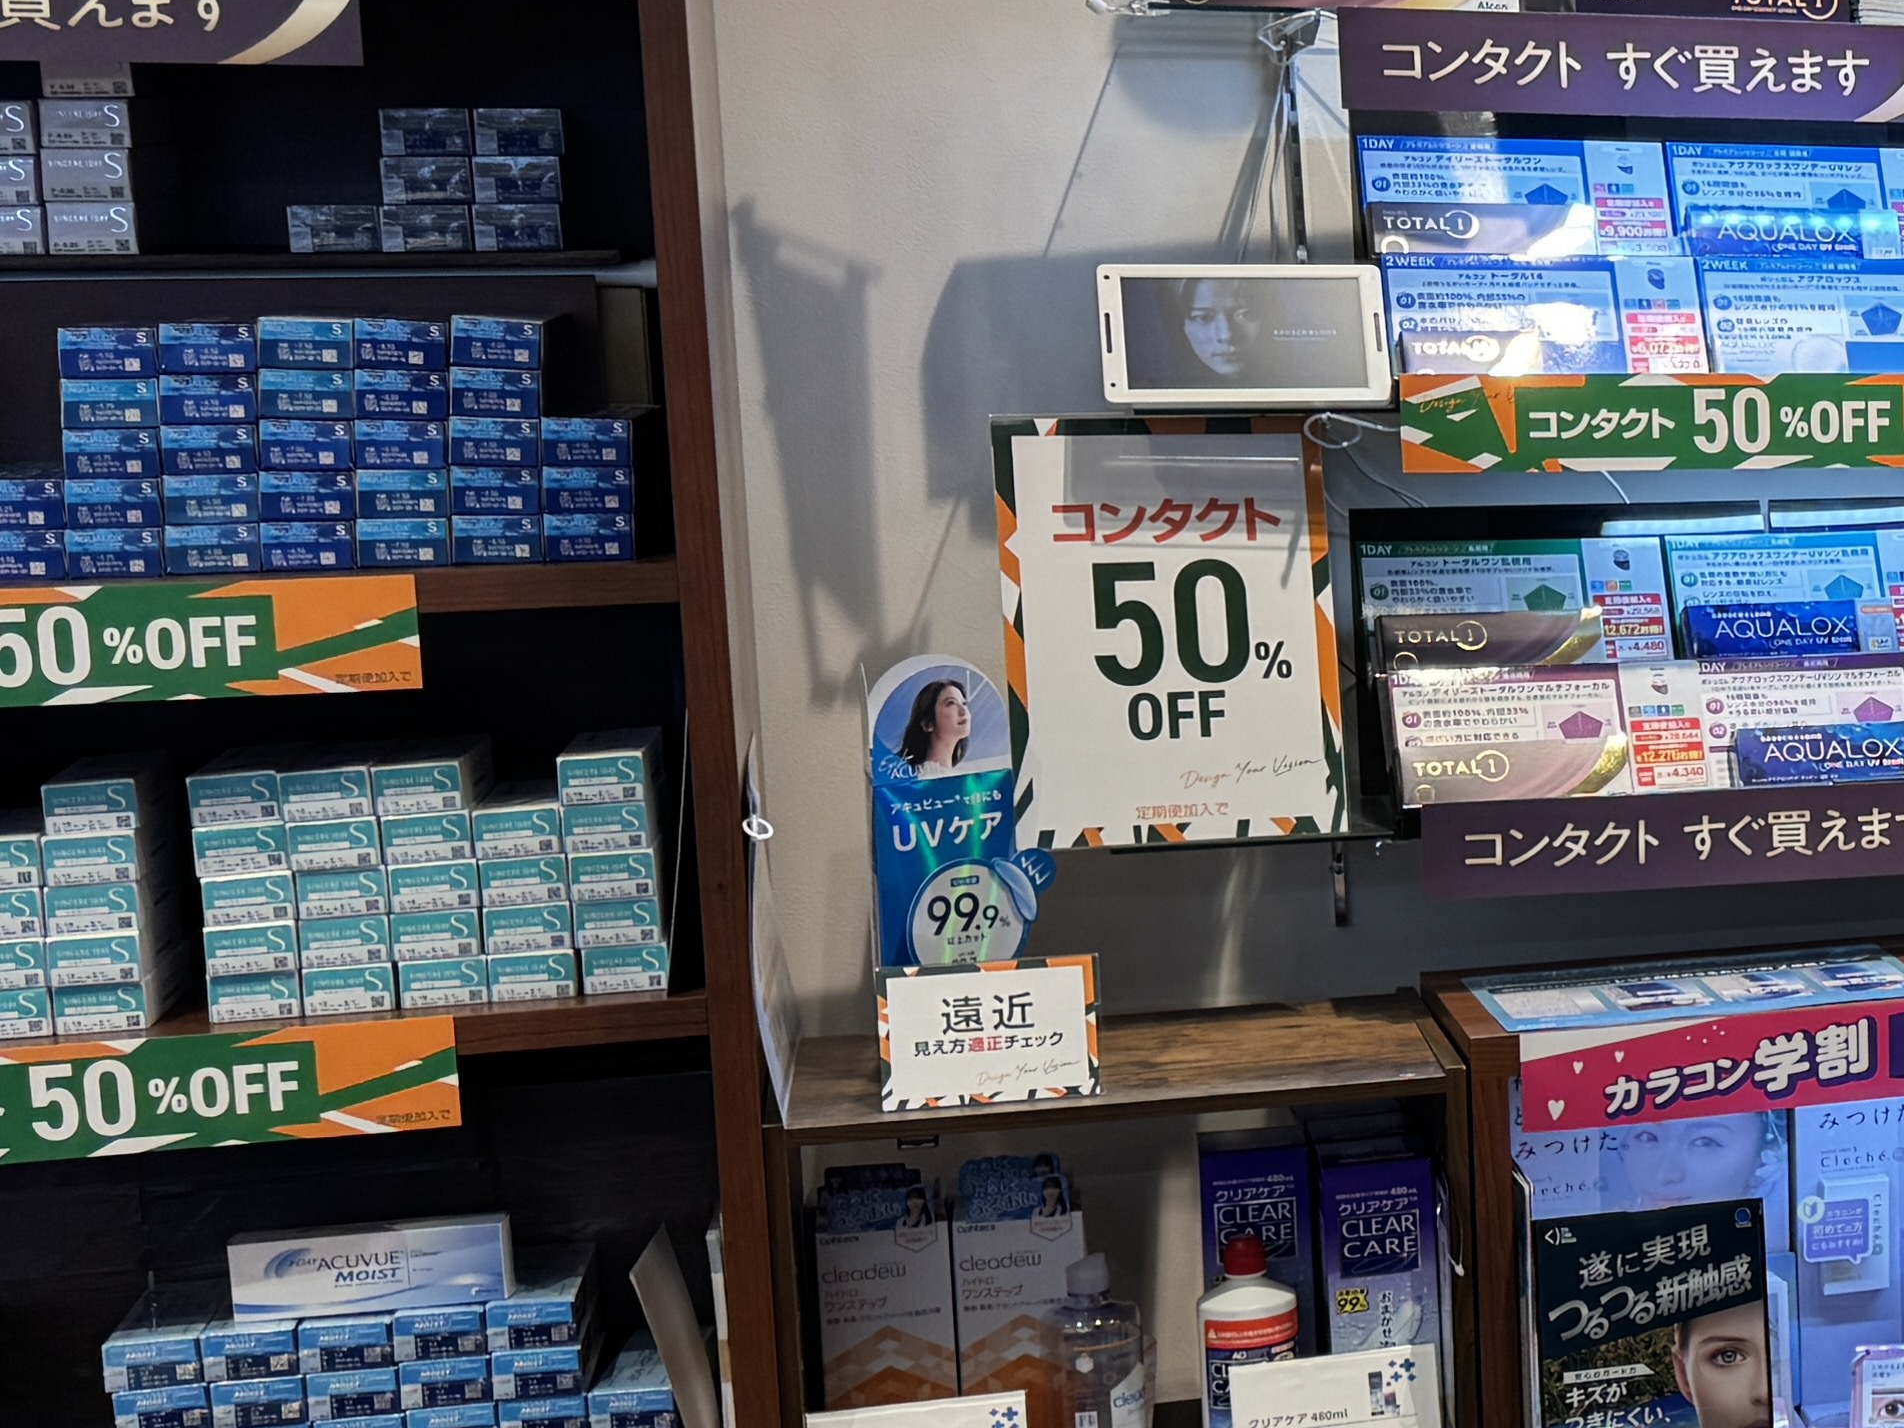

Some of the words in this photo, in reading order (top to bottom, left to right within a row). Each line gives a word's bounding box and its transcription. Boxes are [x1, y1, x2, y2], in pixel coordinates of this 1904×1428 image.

[1380, 37, 1581, 88] コンタクト
[1606, 43, 1870, 98] すぐ買えます
[1361, 137, 1396, 151] 1DAY
[1672, 144, 1703, 157] 1DAY
[1717, 214, 1855, 244] AQUALOX
[1528, 406, 1676, 442] コンタクト
[1051, 497, 1282, 545] コンタクト
[1714, 615, 1851, 641] AQUALOX
[1127, 689, 1226, 741] OFF
[1763, 737, 1900, 764] AQUALOX
[1135, 800, 1230, 821] 定期便加入で
[891, 810, 1003, 853] UVケア
[1464, 818, 1660, 868] コンタクト
[940, 991, 1035, 1037] 遠近
[914, 1030, 1065, 1057] 見え方適正チェック
[1604, 1017, 1875, 1116] カラコン学割
[1215, 1185, 1287, 1204] クリアケア
[1337, 1197, 1410, 1216] クリアケア
[1218, 1202, 1293, 1225] CLEAR
[1341, 1214, 1415, 1239] CLEAR
[1343, 1236, 1417, 1259] CARE
[1579, 1223, 1713, 1290] 遂に実現
[316, 1249, 402, 1274] ACUVUE
[959, 1252, 1042, 1273] cleadew
[334, 1266, 402, 1286] MOIST
[1548, 1252, 1754, 1341] つるつる新触感
[1564, 1380, 1629, 1406] キズが
